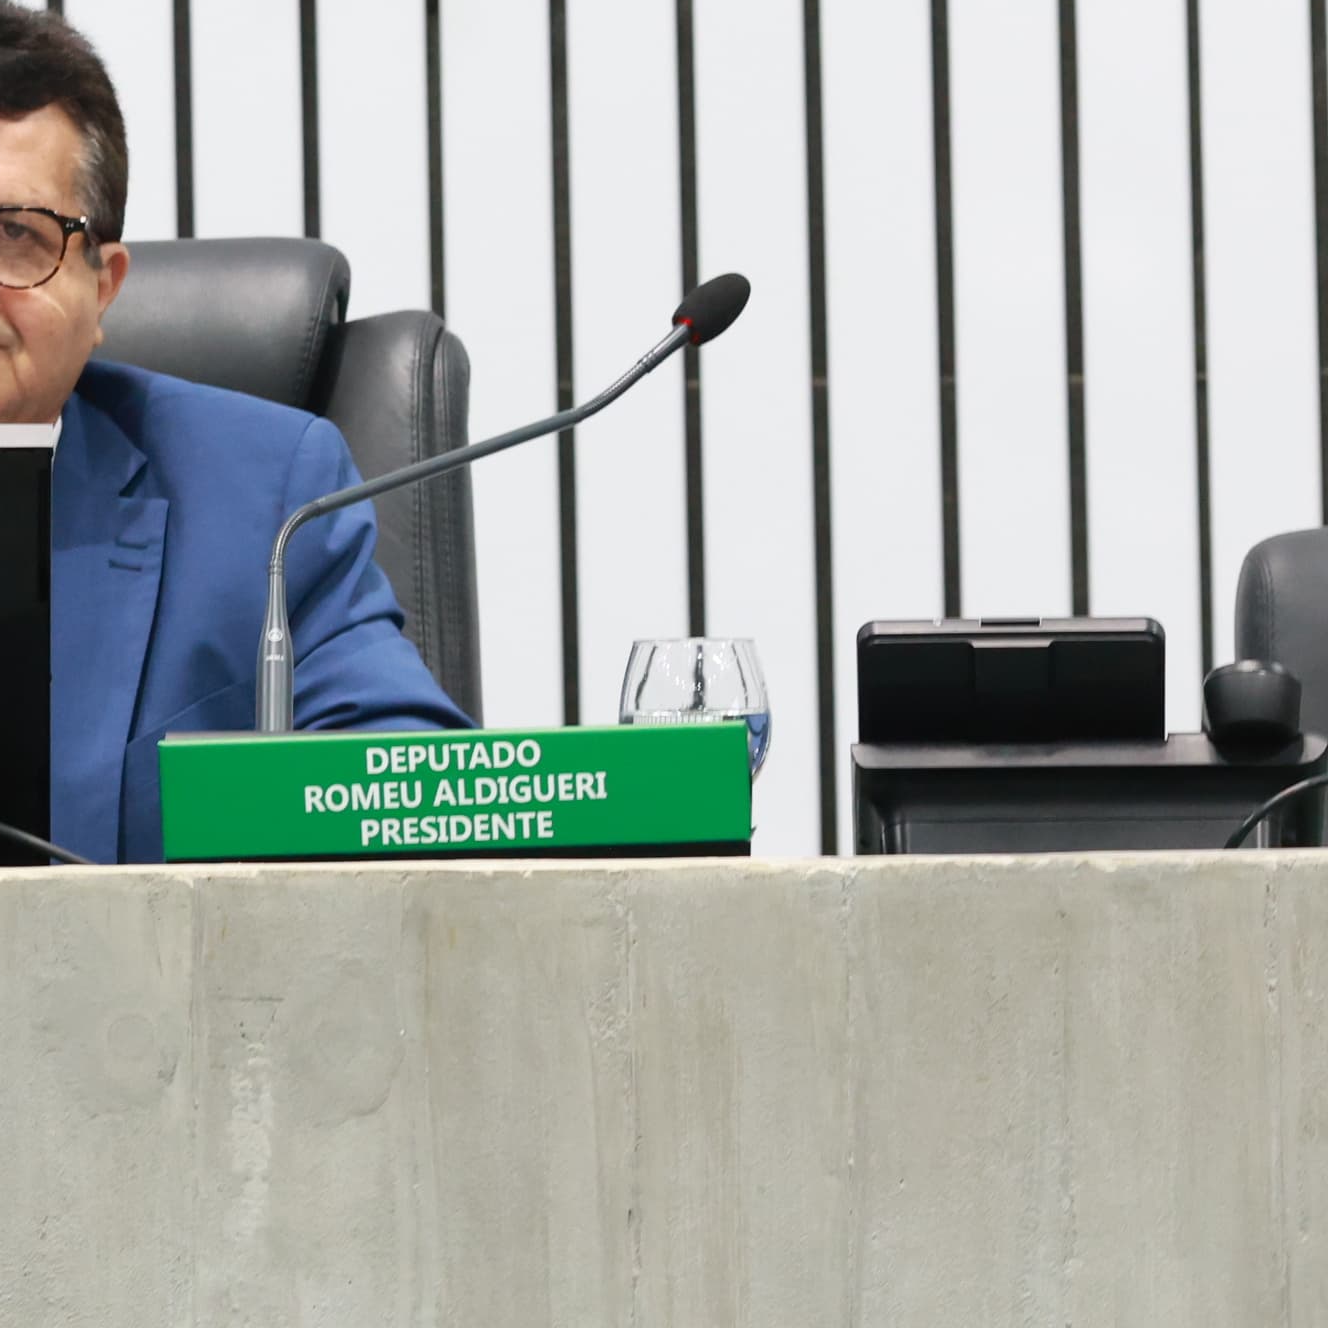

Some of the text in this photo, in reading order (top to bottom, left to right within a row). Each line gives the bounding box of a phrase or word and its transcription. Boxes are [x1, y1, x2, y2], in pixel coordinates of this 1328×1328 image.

[366, 739, 542, 775] DEPUTADO
[304, 771, 608, 813] ROMEU ALDIGUERI
[361, 811, 555, 846] PRESIDENTE
